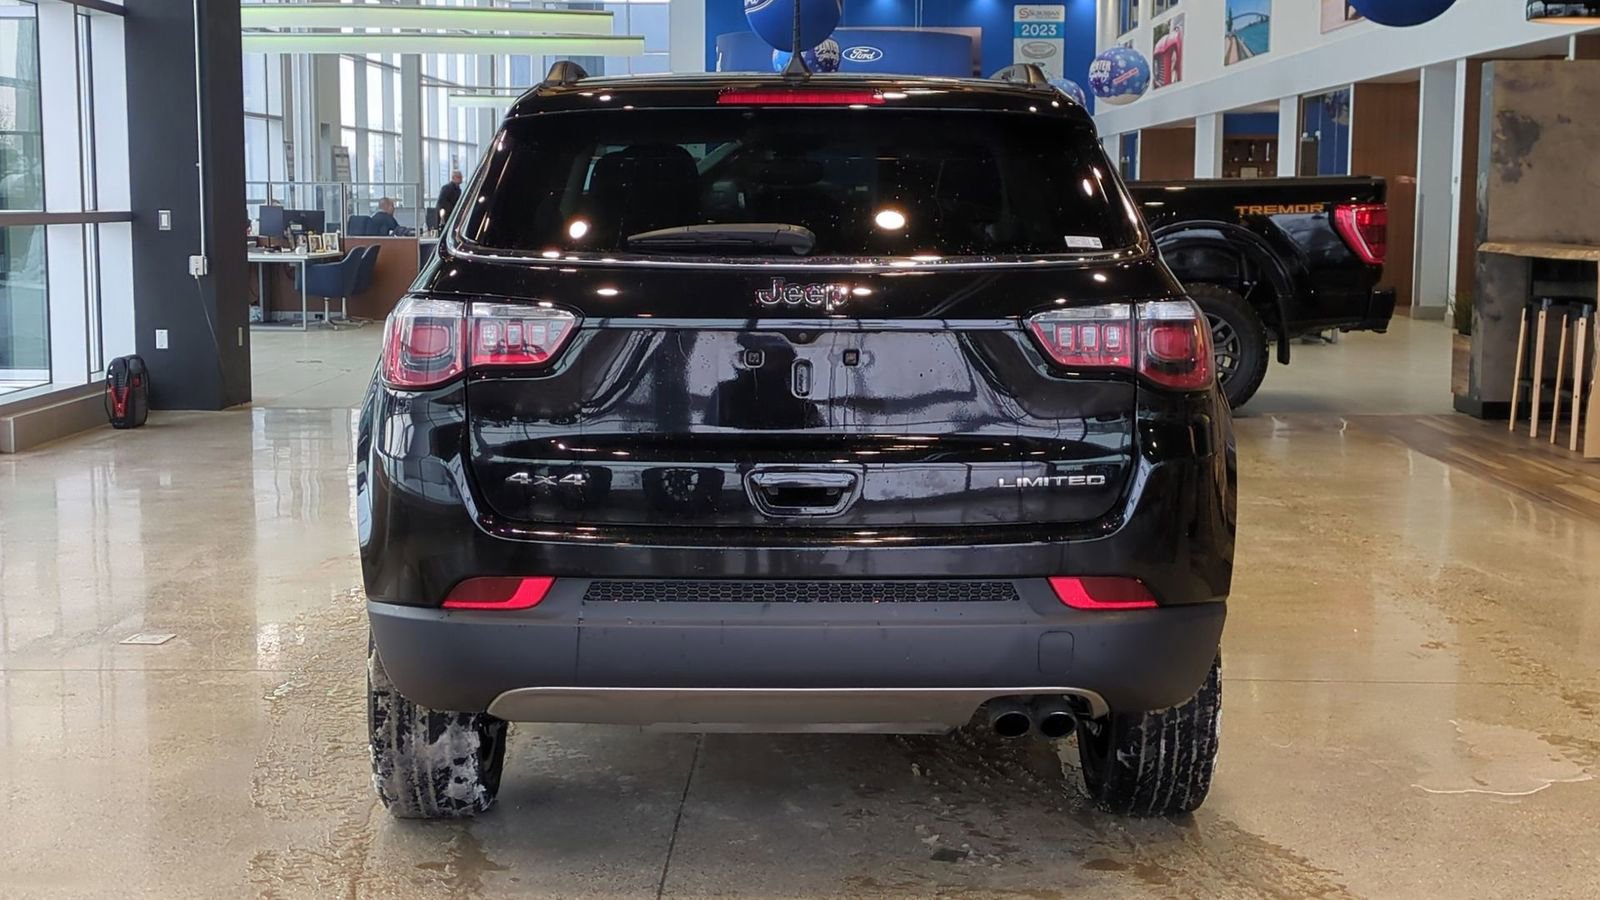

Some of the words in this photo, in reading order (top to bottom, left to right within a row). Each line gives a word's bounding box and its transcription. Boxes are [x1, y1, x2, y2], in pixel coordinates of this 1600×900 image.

[1021, 24, 1057, 36] 2023
[850, 48, 875, 59] Ford
[1234, 203, 1325, 215] TREMOR
[756, 276, 848, 314] Jeep
[998, 475, 1106, 488] LIMITED
